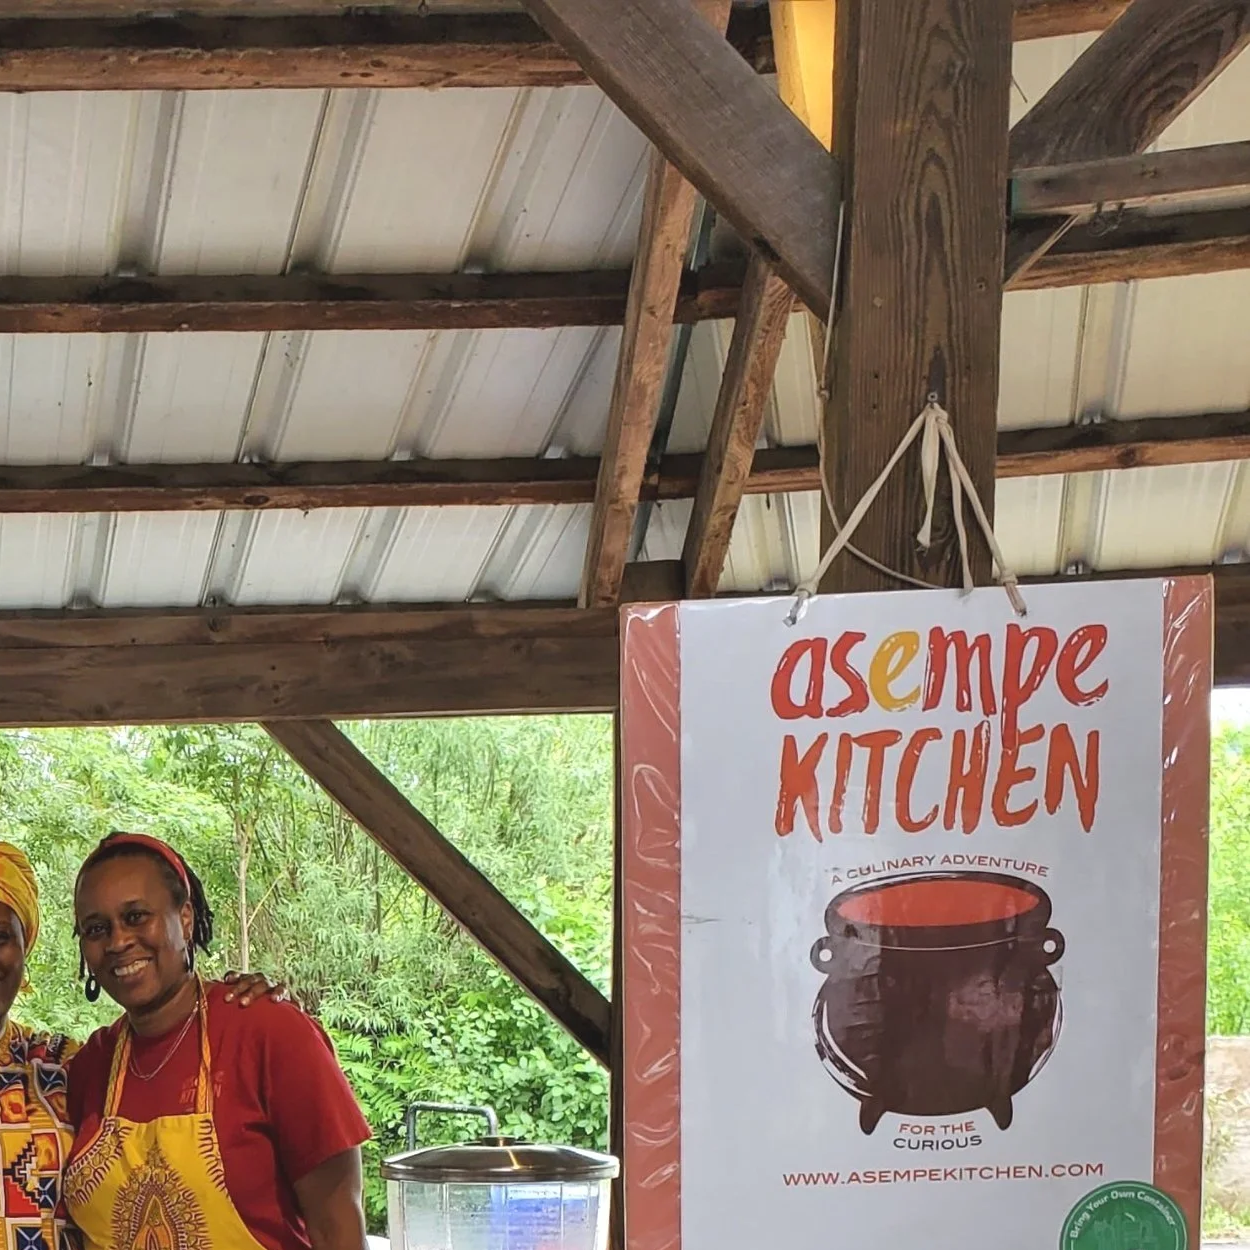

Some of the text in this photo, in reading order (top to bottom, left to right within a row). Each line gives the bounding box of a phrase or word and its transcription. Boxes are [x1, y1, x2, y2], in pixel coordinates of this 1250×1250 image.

[770, 623, 1109, 750] asempe
[774, 720, 1100, 843] KITCHEN
[831, 854, 1050, 886] A CULINARY ADVENTURE
[892, 1135, 983, 1151] CURIOUS
[899, 1120, 976, 1135] FOR THE
[782, 1163, 1105, 1187] WWW.ASEMPEKITCHEN.COM
[1069, 1190, 1176, 1239] Bring Your Own Container
